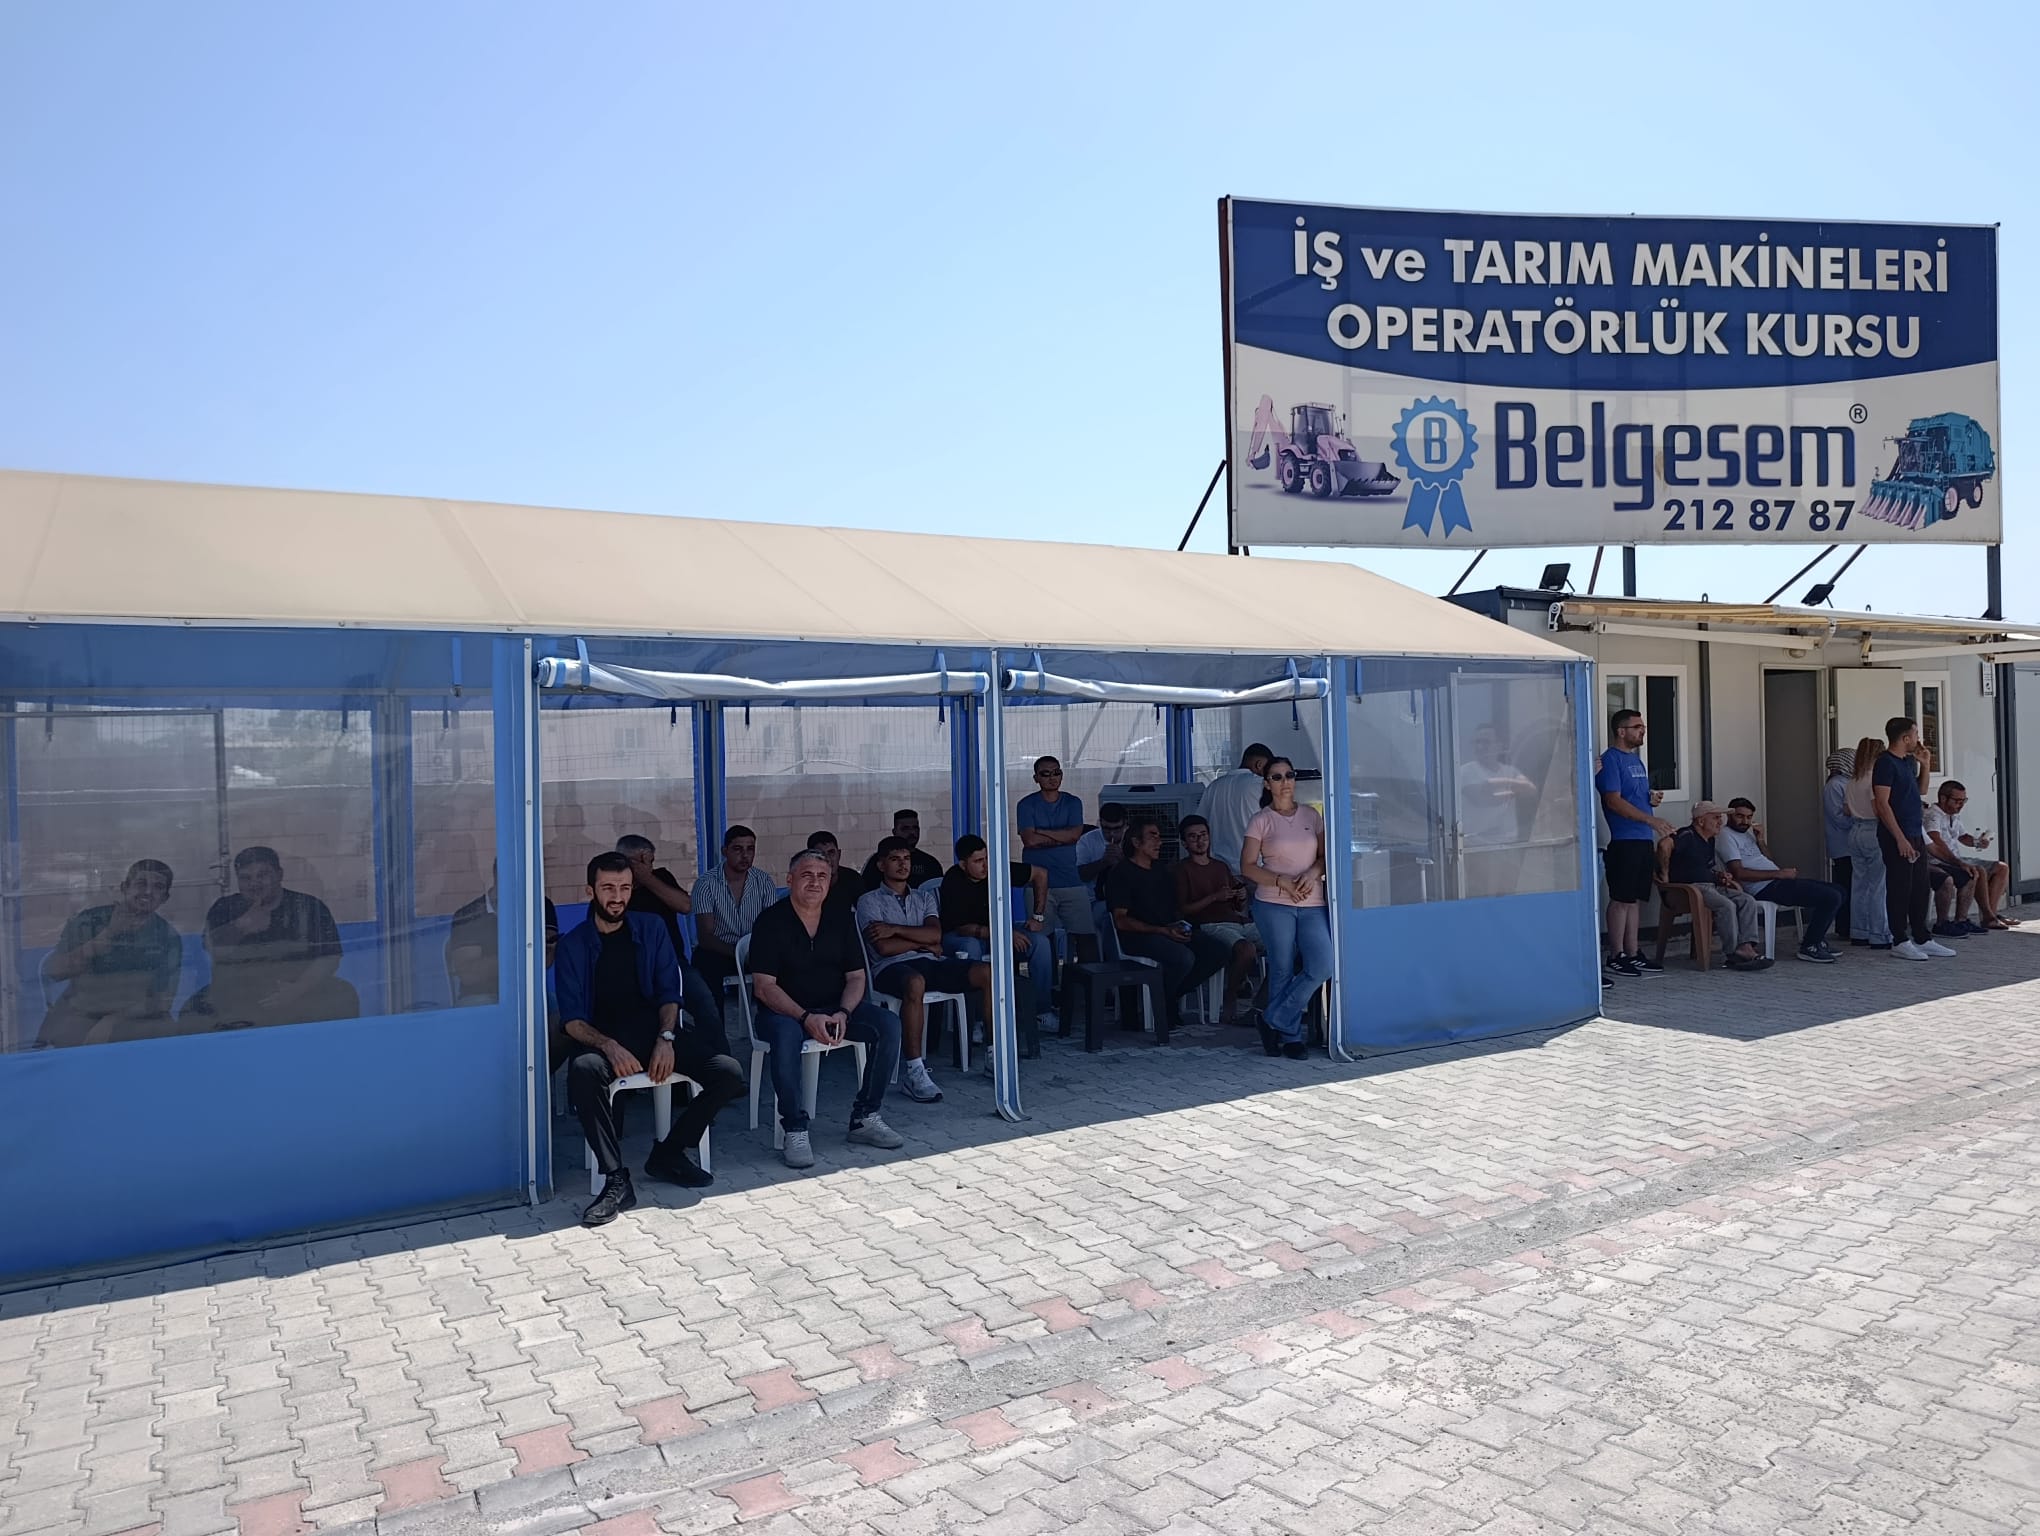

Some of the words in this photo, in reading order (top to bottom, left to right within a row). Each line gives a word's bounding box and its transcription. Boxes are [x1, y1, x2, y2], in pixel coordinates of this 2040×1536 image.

[1294, 216, 1343, 290] İŞ
[1360, 247, 1426, 282] ve
[1444, 238, 1614, 286] TARIM
[1631, 232, 1948, 292] MAKİNELERİ
[1327, 296, 1729, 355] OPERATÖRLÜK
[1747, 312, 1920, 359] KURSU
[1424, 417, 1447, 464] B
[1495, 401, 1856, 511] Belgesem
[1663, 499, 1734, 531] 212
[1749, 499, 1795, 531] 87
[1809, 499, 1855, 531] 87
